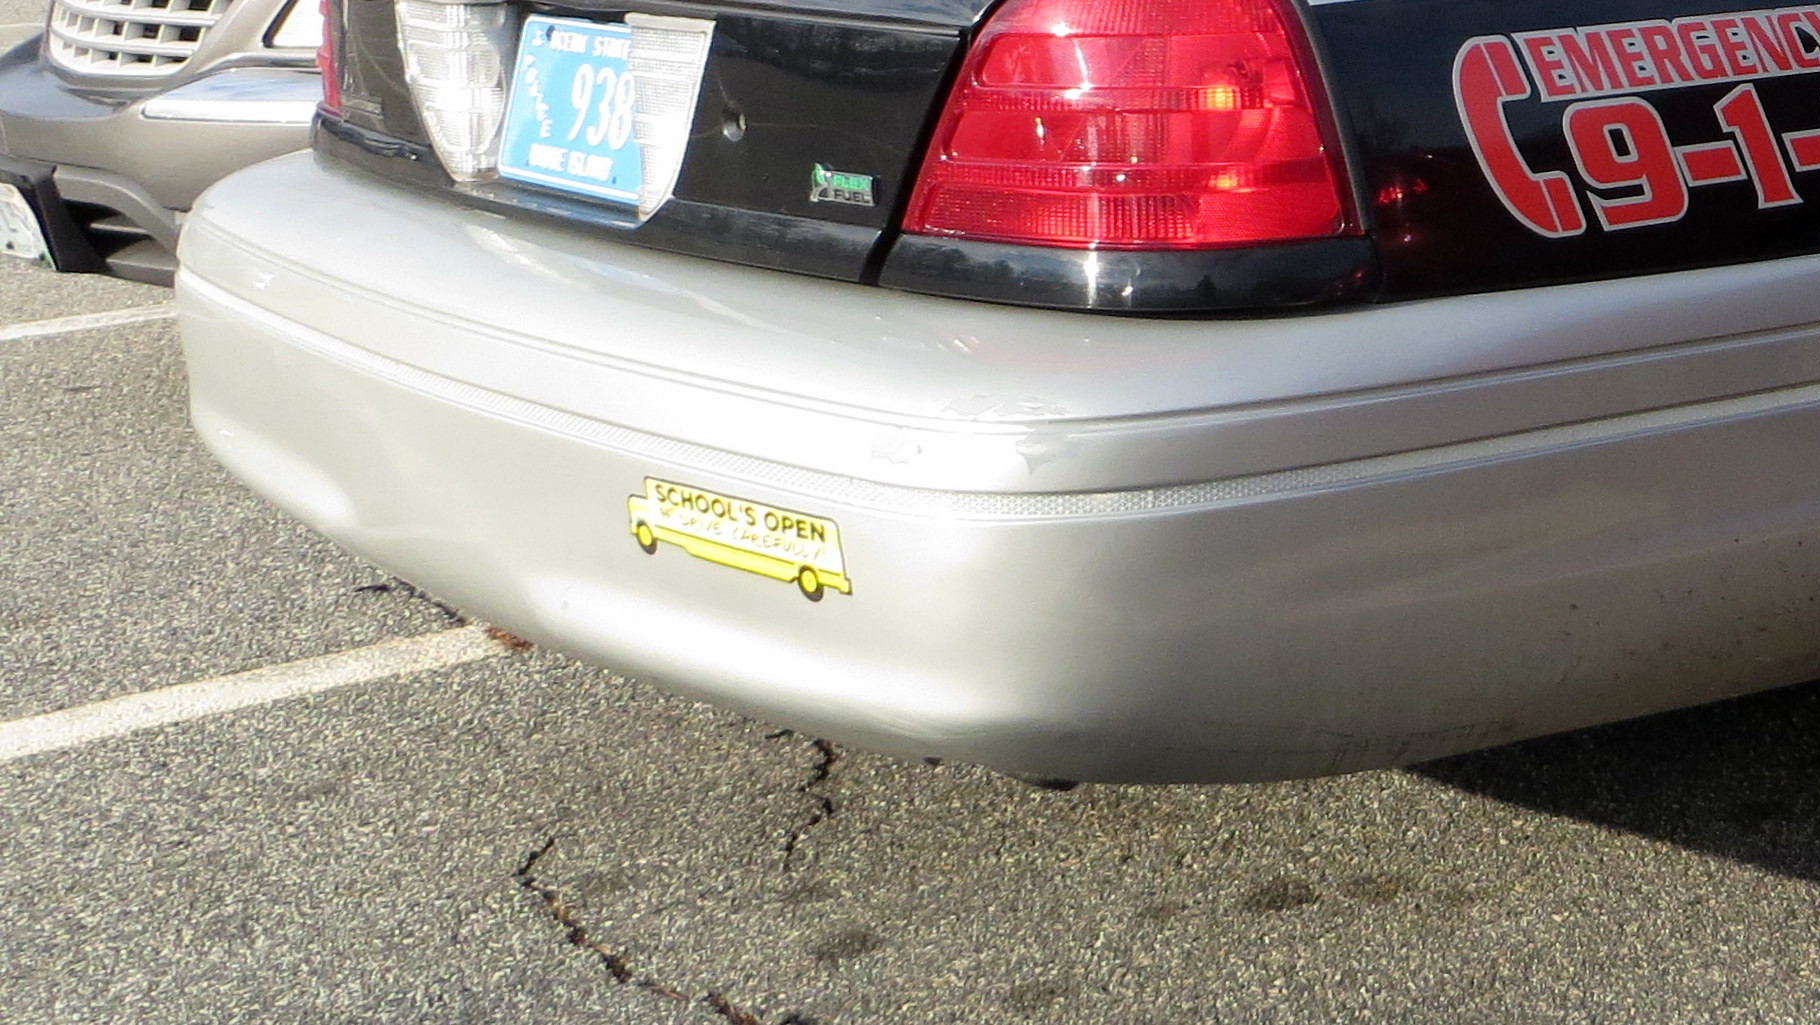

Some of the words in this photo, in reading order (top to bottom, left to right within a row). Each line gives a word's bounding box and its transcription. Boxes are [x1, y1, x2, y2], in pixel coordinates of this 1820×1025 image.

[567, 63, 636, 150] 938
[655, 484, 756, 526] SCHOOL'S
[764, 512, 826, 542] OPEN
